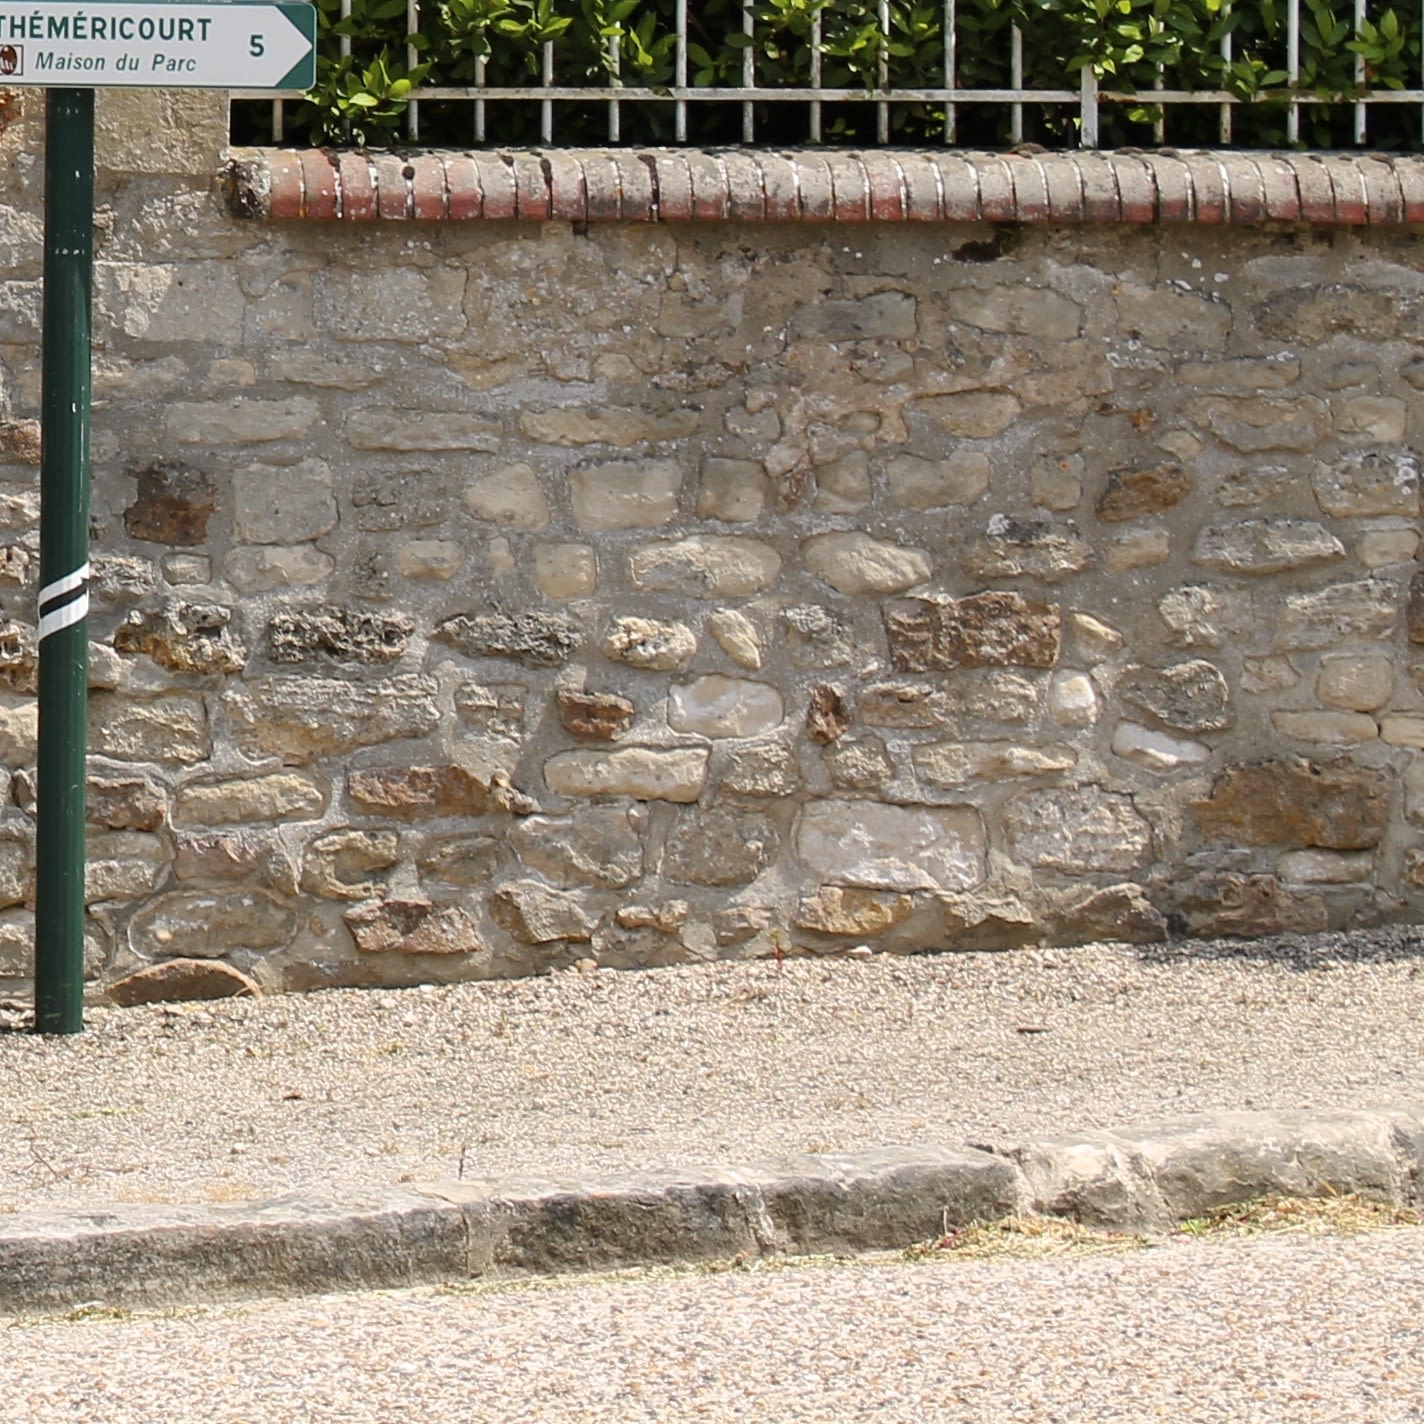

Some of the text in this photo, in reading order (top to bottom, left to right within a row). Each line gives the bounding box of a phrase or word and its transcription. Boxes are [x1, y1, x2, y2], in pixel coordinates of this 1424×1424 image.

[249, 34, 265, 58] 5
[35, 51, 197, 72] Maison du Parc
